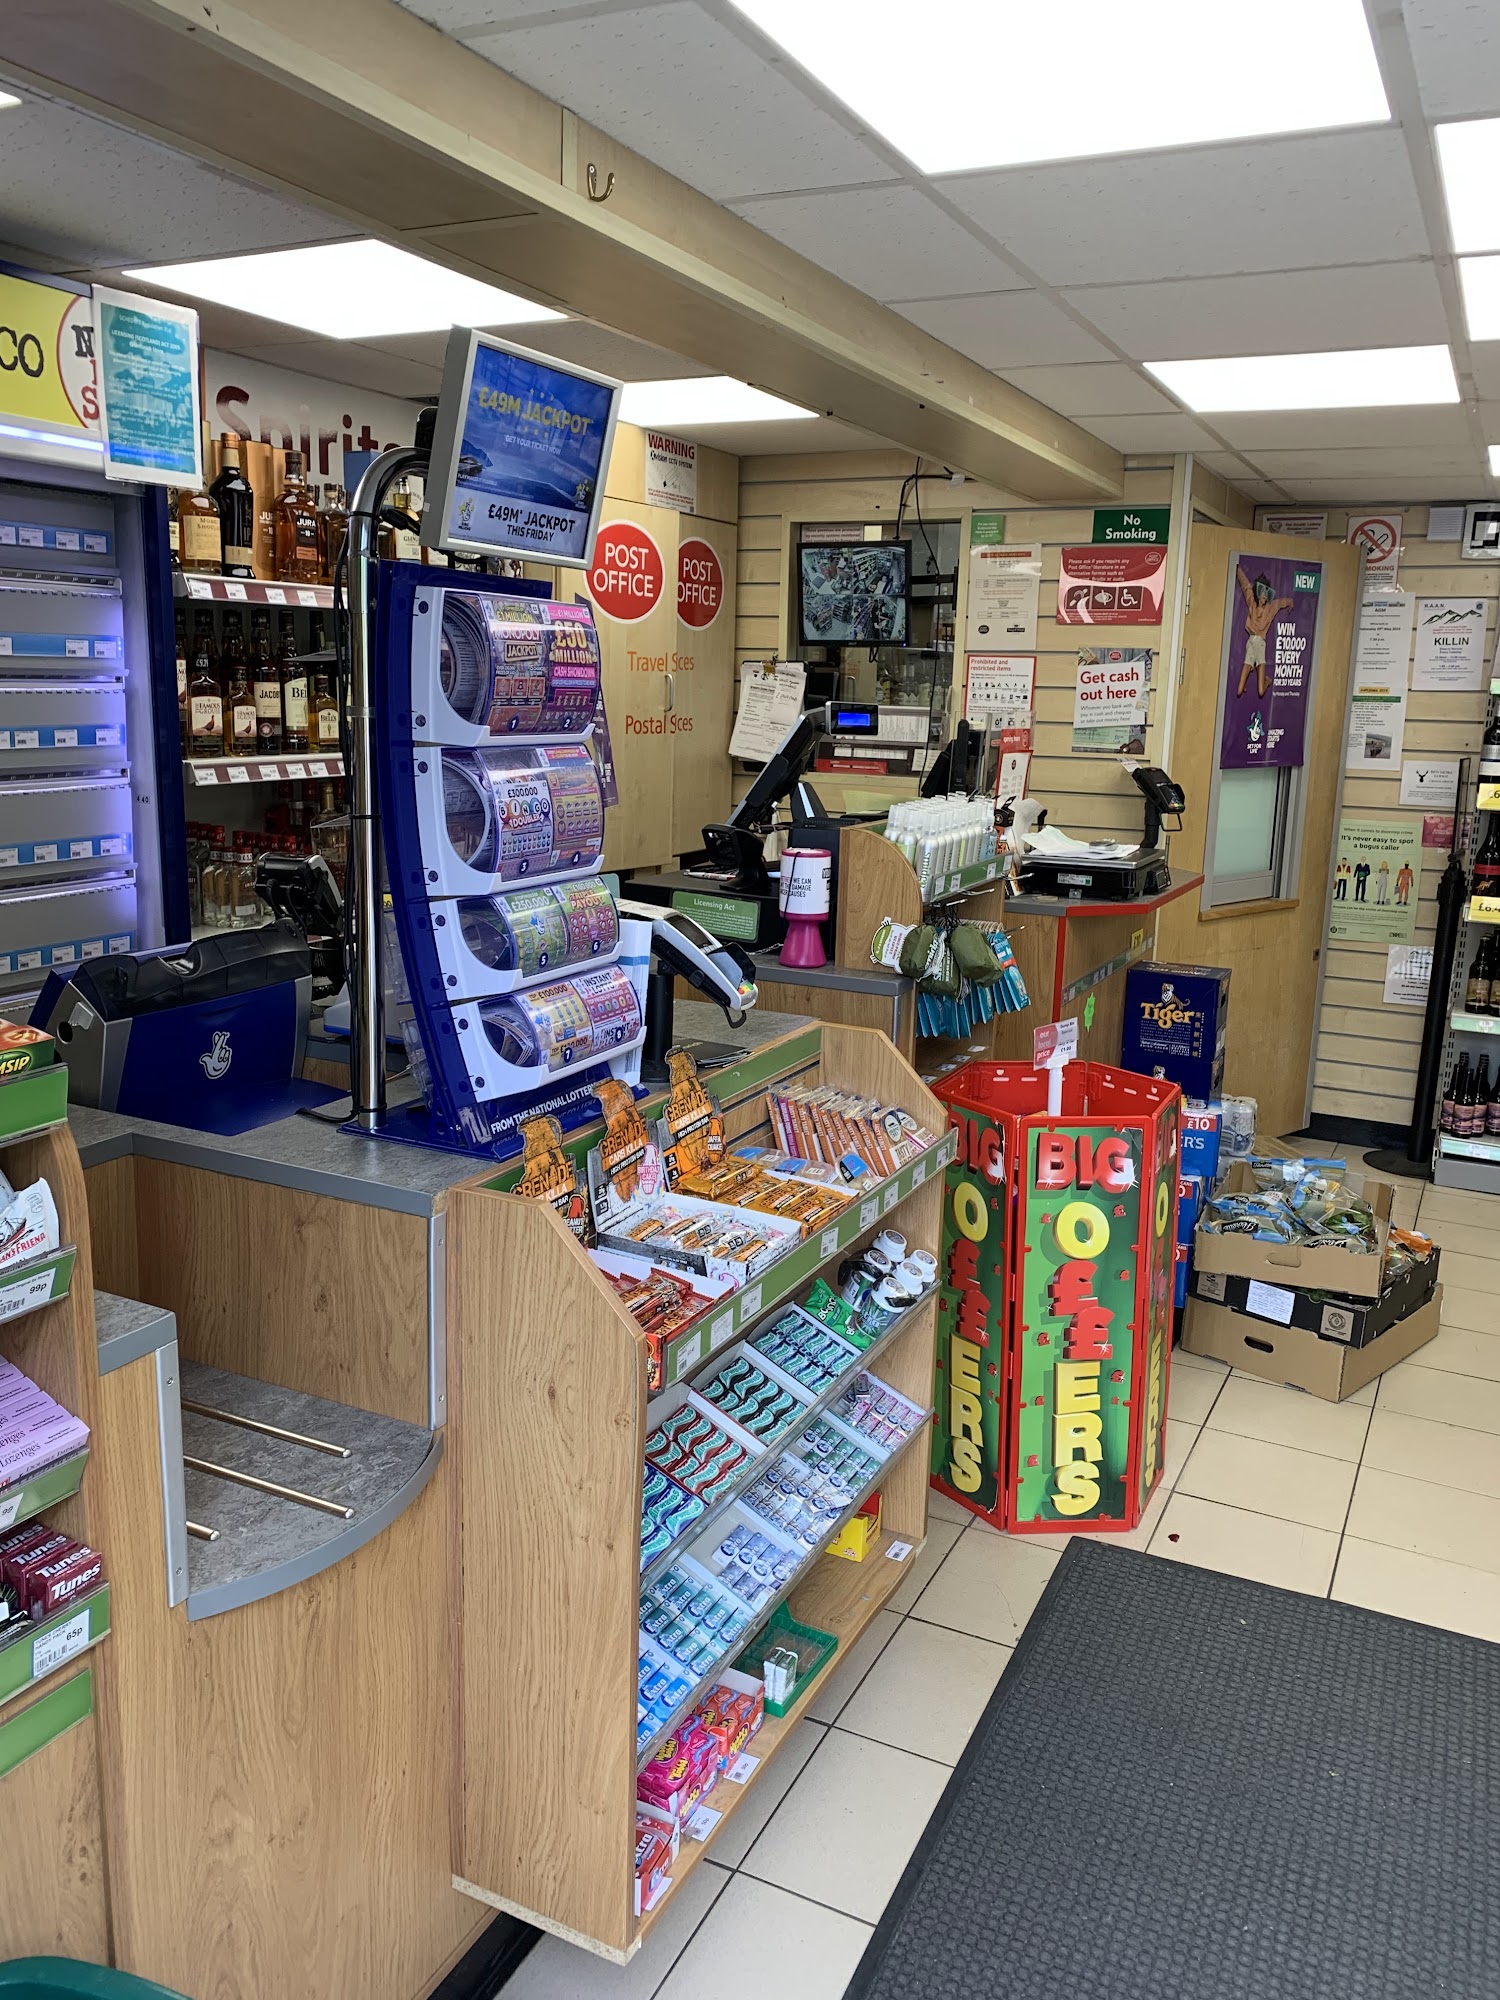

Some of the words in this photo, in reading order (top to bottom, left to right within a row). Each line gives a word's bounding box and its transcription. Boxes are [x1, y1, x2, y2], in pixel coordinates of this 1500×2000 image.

[478, 387, 521, 417] £49M
[523, 401, 592, 436] JACKPOT
[216, 385, 402, 476] Spirit
[505, 434, 516, 444] GET
[517, 437, 531, 448] YOUR
[531, 441, 549, 452] TICKET
[648, 433, 695, 460] WARNING
[297, 517, 316, 528] JURA
[524, 511, 575, 533] JACKPOT
[1123, 514, 1141, 525] No
[507, 524, 525, 537] THIS
[526, 527, 555, 542] FRIDAY
[1105, 528, 1157, 541] Smoking
[605, 542, 649, 570] POST
[683, 557, 713, 582] POST
[593, 568, 654, 598] OFFICE
[1295, 575, 1315, 589] NEW
[678, 581, 716, 606] OFFICE
[494, 626, 540, 640] MONOPOLY
[555, 621, 588, 649] £50
[1277, 622, 1296, 636] WIN
[1434, 637, 1470, 646] KILLIN
[507, 645, 537, 657] JACKPOT
[555, 649, 593, 664] MILLION
[1275, 651, 1301, 664] EVERY
[627, 651, 668, 672] Travel
[1080, 671, 1104, 684] Get
[1109, 667, 1139, 682] cash
[1274, 665, 1304, 678] MONTH
[1287, 678, 1302, 686] YEARS
[1080, 688, 1103, 701] out
[1107, 685, 1137, 700] here
[564, 719, 570, 727] 2
[626, 714, 666, 735] Postal
[1359, 843, 1380, 851] bogus
[521, 862, 527, 871] 3
[571, 896, 603, 910] PAYOUT
[694, 898, 723, 910] Licensing
[724, 903, 736, 911] Act
[584, 973, 611, 987] INSTANT
[1140, 1001, 1196, 1029] Tiger
[1040, 1031, 1050, 1039] our
[1036, 1049, 1051, 1062] price
[491, 1118, 515, 1134] FROM
[514, 1111, 530, 1126] THE
[529, 1096, 567, 1118] NATIONAL
[674, 1115, 691, 1130] CARB
[691, 1106, 707, 1122] KILLA
[1187, 1119, 1210, 1131] £10
[608, 1149, 625, 1165] CARB
[625, 1139, 643, 1156] KILLA
[949, 1115, 1004, 1185] BIG
[1036, 1132, 1137, 1193] BIG
[545, 1184, 568, 1202] KILLA
[15, 1232, 46, 1254] FRIEND
[29, 1283, 47, 1294] 99p
[0, 1443, 41, 1468] Lozenges
[11, 1535, 66, 1565] Tunes
[36, 1546, 91, 1578] Tunes
[51, 1563, 100, 1600] Tunes
[650, 1614, 667, 1631] Extra
[36, 1634, 52, 1646] TUNES
[52, 1621, 72, 1635] CHERRY
[66, 1627, 83, 1640] 65p
[693, 1655, 713, 1673] Extra
[665, 1685, 687, 1706] Extra
